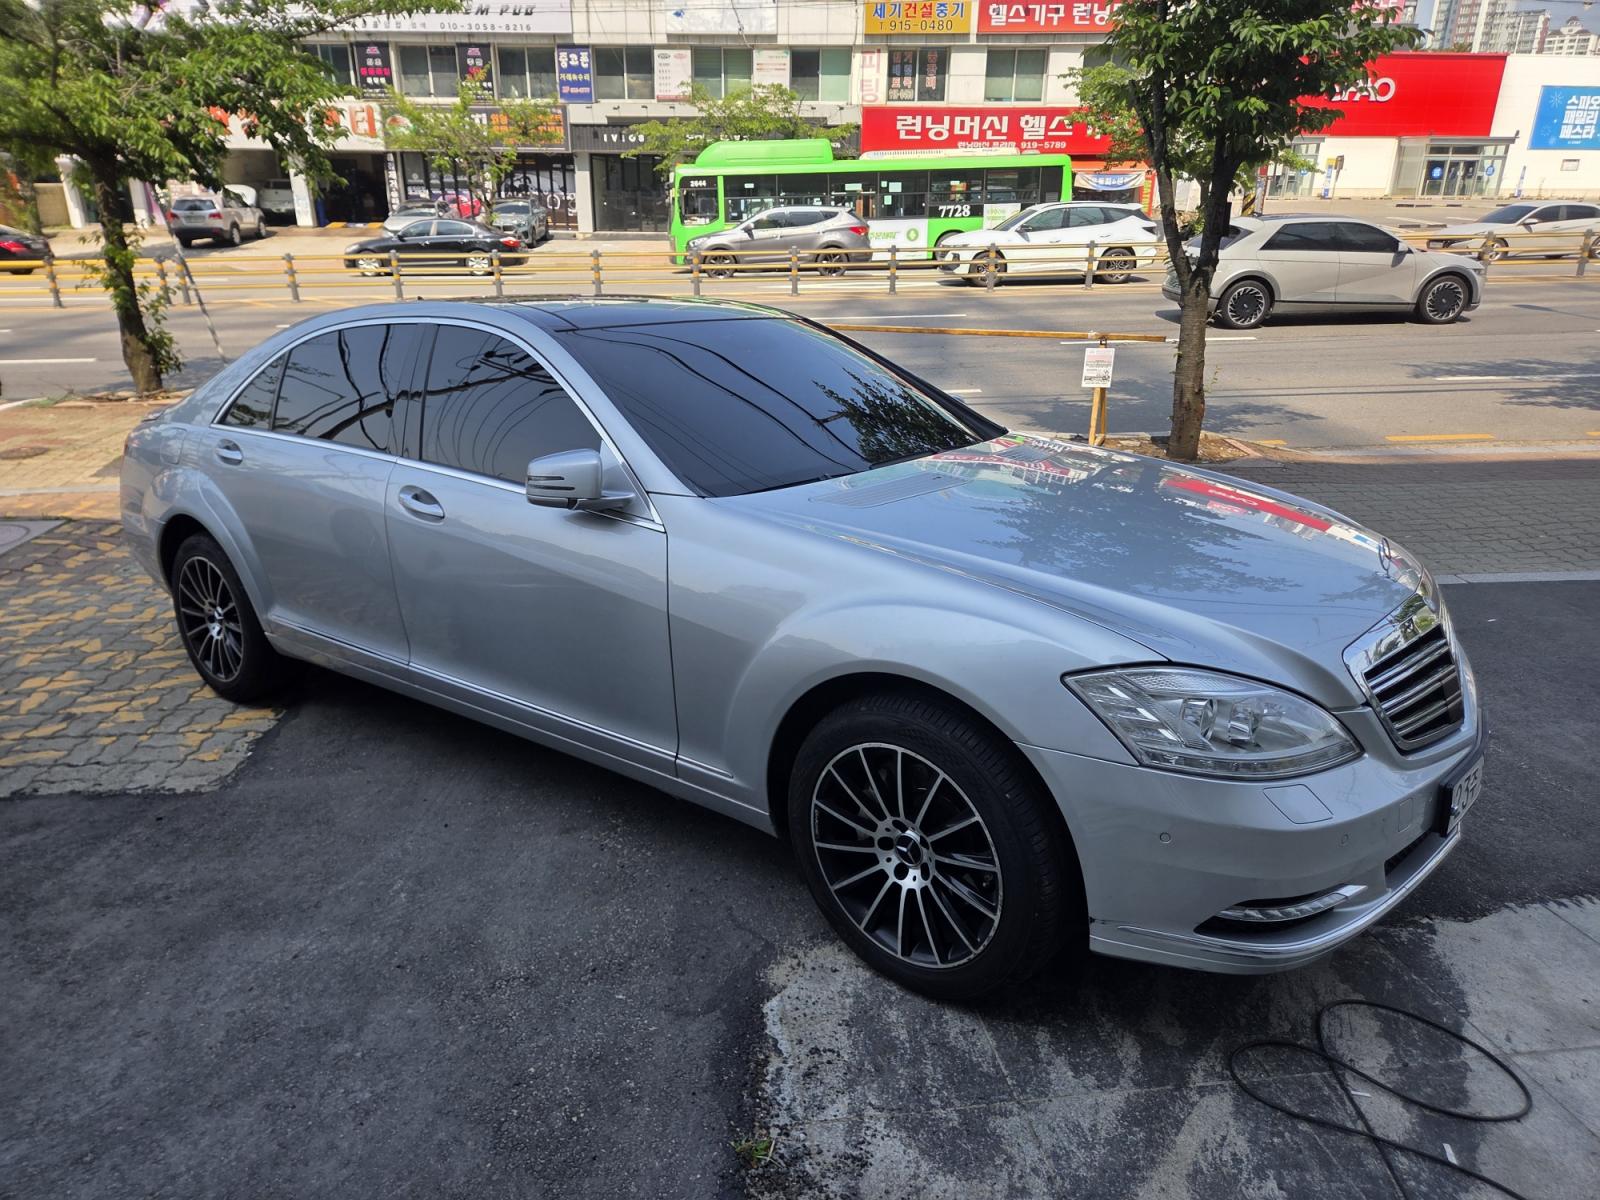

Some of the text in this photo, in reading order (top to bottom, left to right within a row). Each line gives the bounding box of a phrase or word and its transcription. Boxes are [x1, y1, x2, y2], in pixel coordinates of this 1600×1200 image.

[873, 2, 965, 18] 세기건설중기
[988, 3, 1121, 26] 헬스기구 런닝
[889, 19, 953, 31] 915-0480
[896, 115, 1008, 140] 런닝머신
[1020, 141, 1067, 149] 919-5789
[938, 204, 971, 218] 7728
